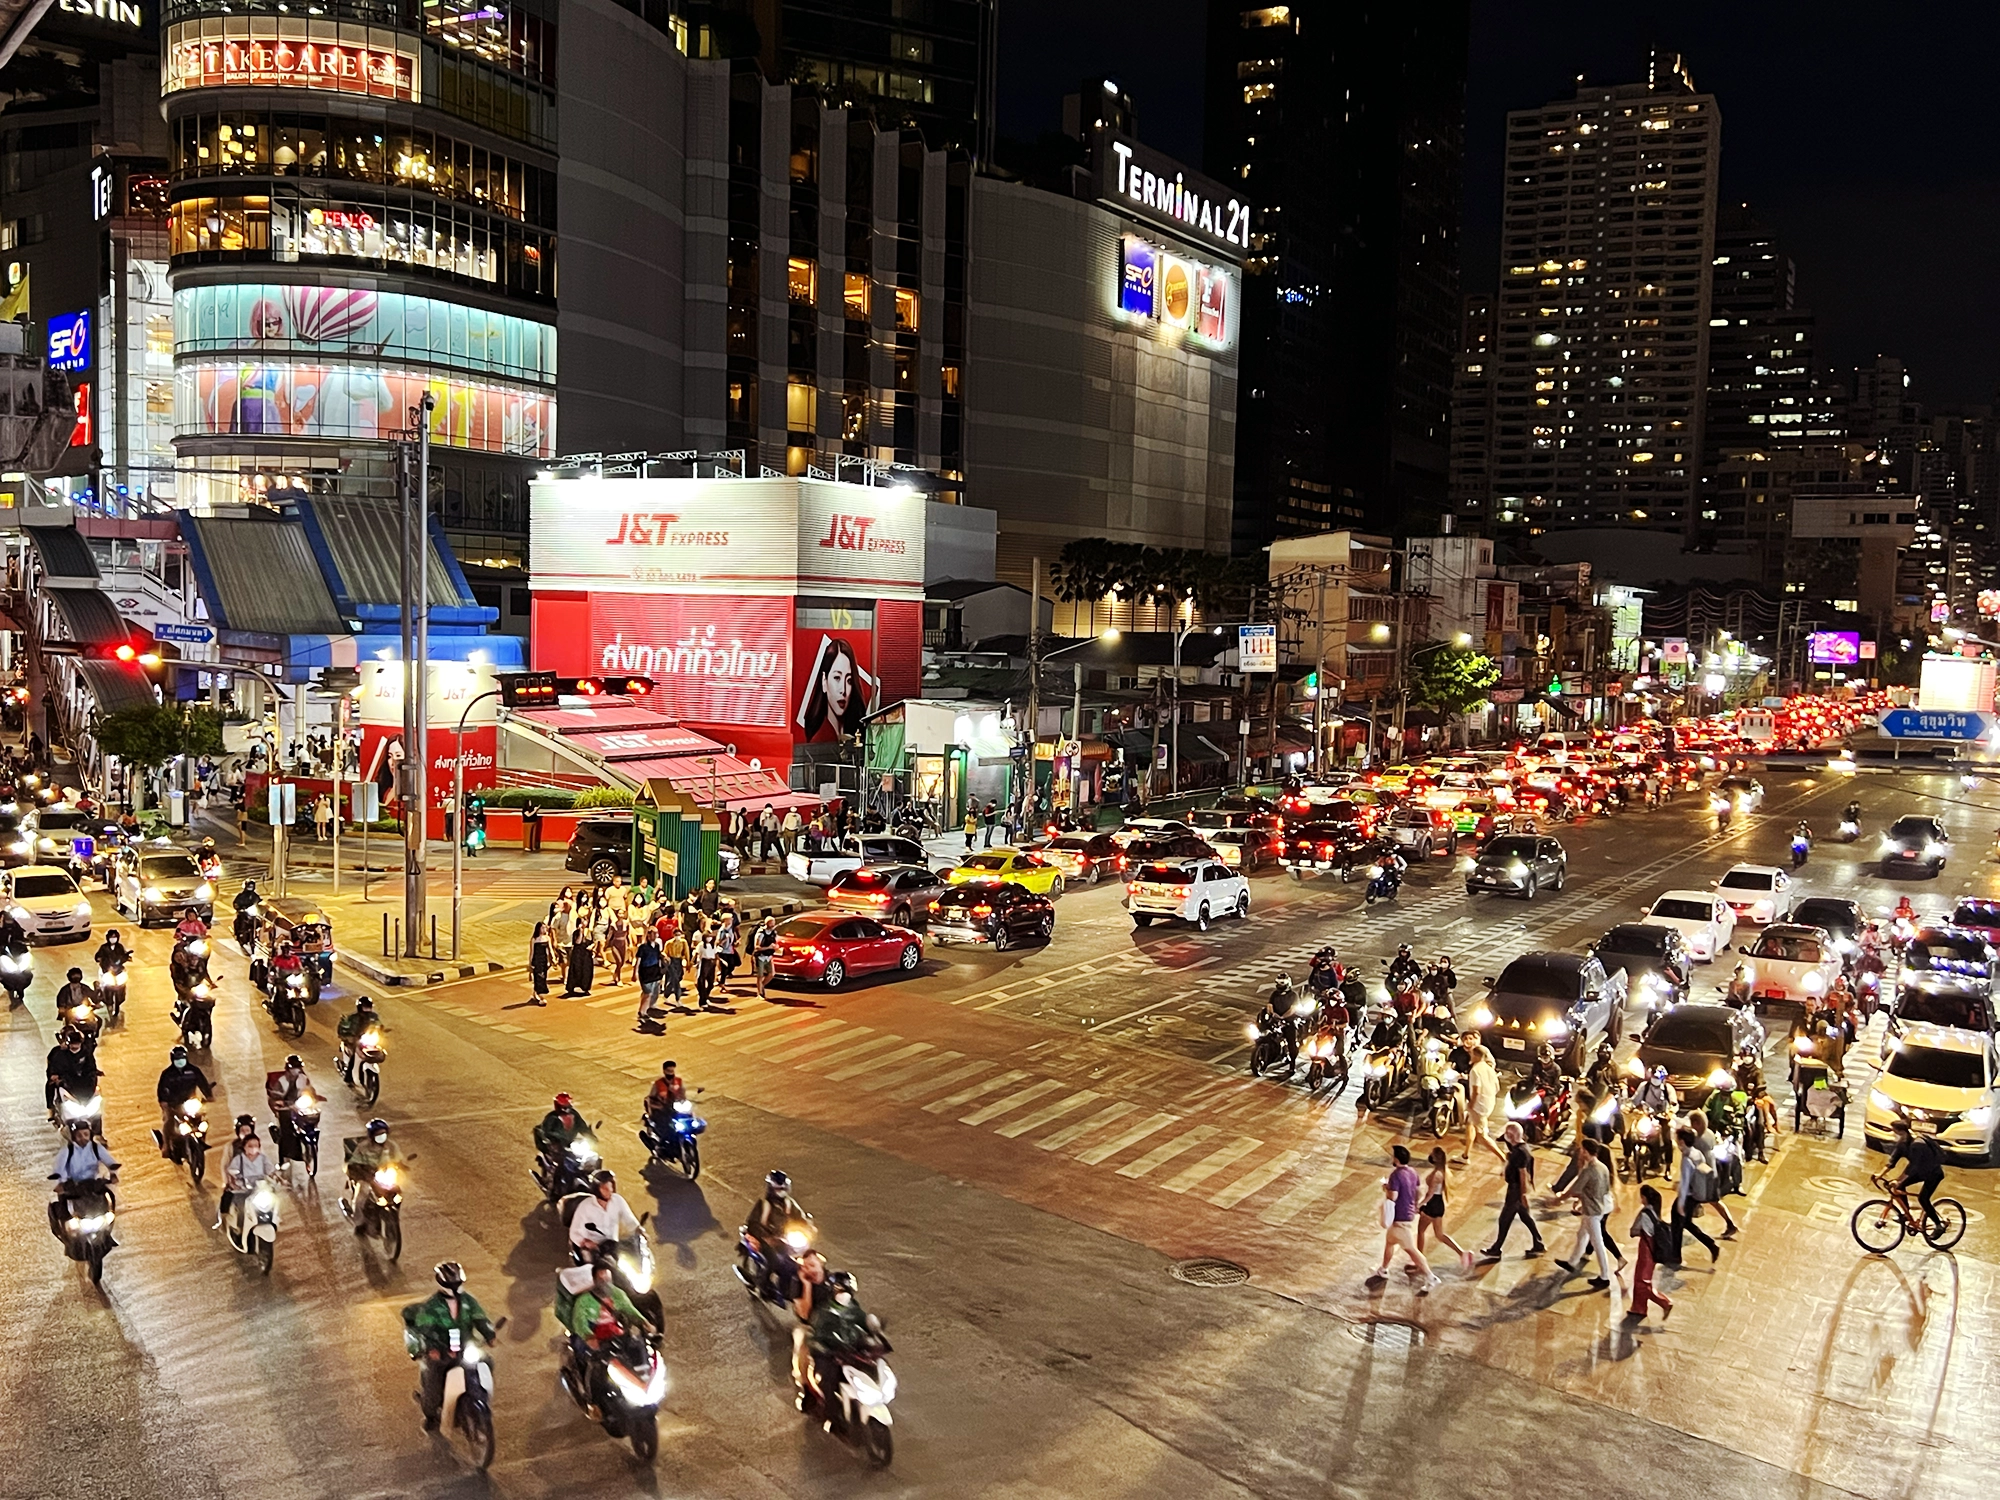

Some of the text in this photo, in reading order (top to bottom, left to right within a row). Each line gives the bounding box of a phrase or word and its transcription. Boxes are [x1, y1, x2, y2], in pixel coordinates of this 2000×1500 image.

[204, 48, 358, 77] TAKECARE
[605, 513, 730, 546] J&T EXPRESS
[819, 513, 876, 551] J&T
[602, 625, 778, 678] ส่งทุกที่ทั่วไทย
[1903, 729, 1944, 737] Sukhumvit
[1919, 713, 1967, 730] สุขุมวิท
